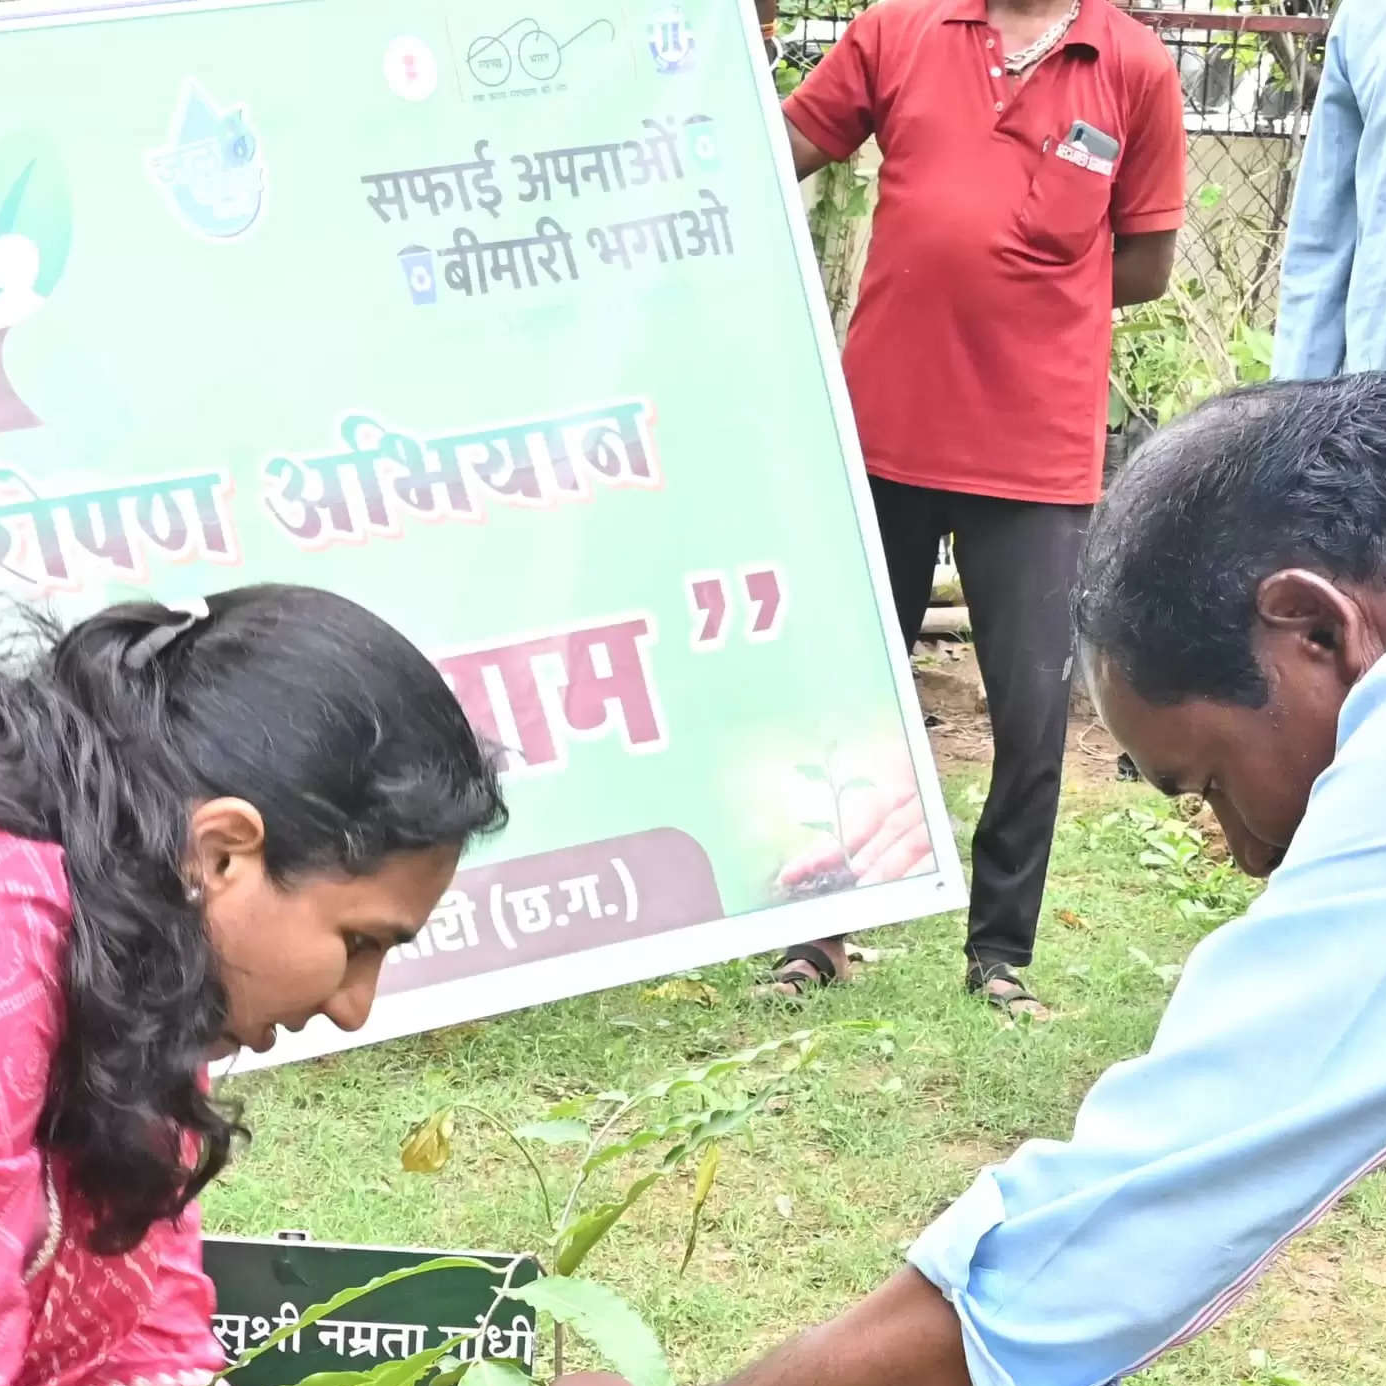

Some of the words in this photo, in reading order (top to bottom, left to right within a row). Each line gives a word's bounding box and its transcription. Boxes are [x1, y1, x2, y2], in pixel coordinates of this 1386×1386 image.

[360, 139, 503, 223] सफाई
[510, 115, 685, 202] अपनाओं
[437, 216, 580, 297] बीमारी
[586, 189, 735, 270] भगाओ
[265, 402, 653, 542] अभियान
[490, 857, 639, 950] (छ.ग.)
[315, 1318, 429, 1359] नम्रता
